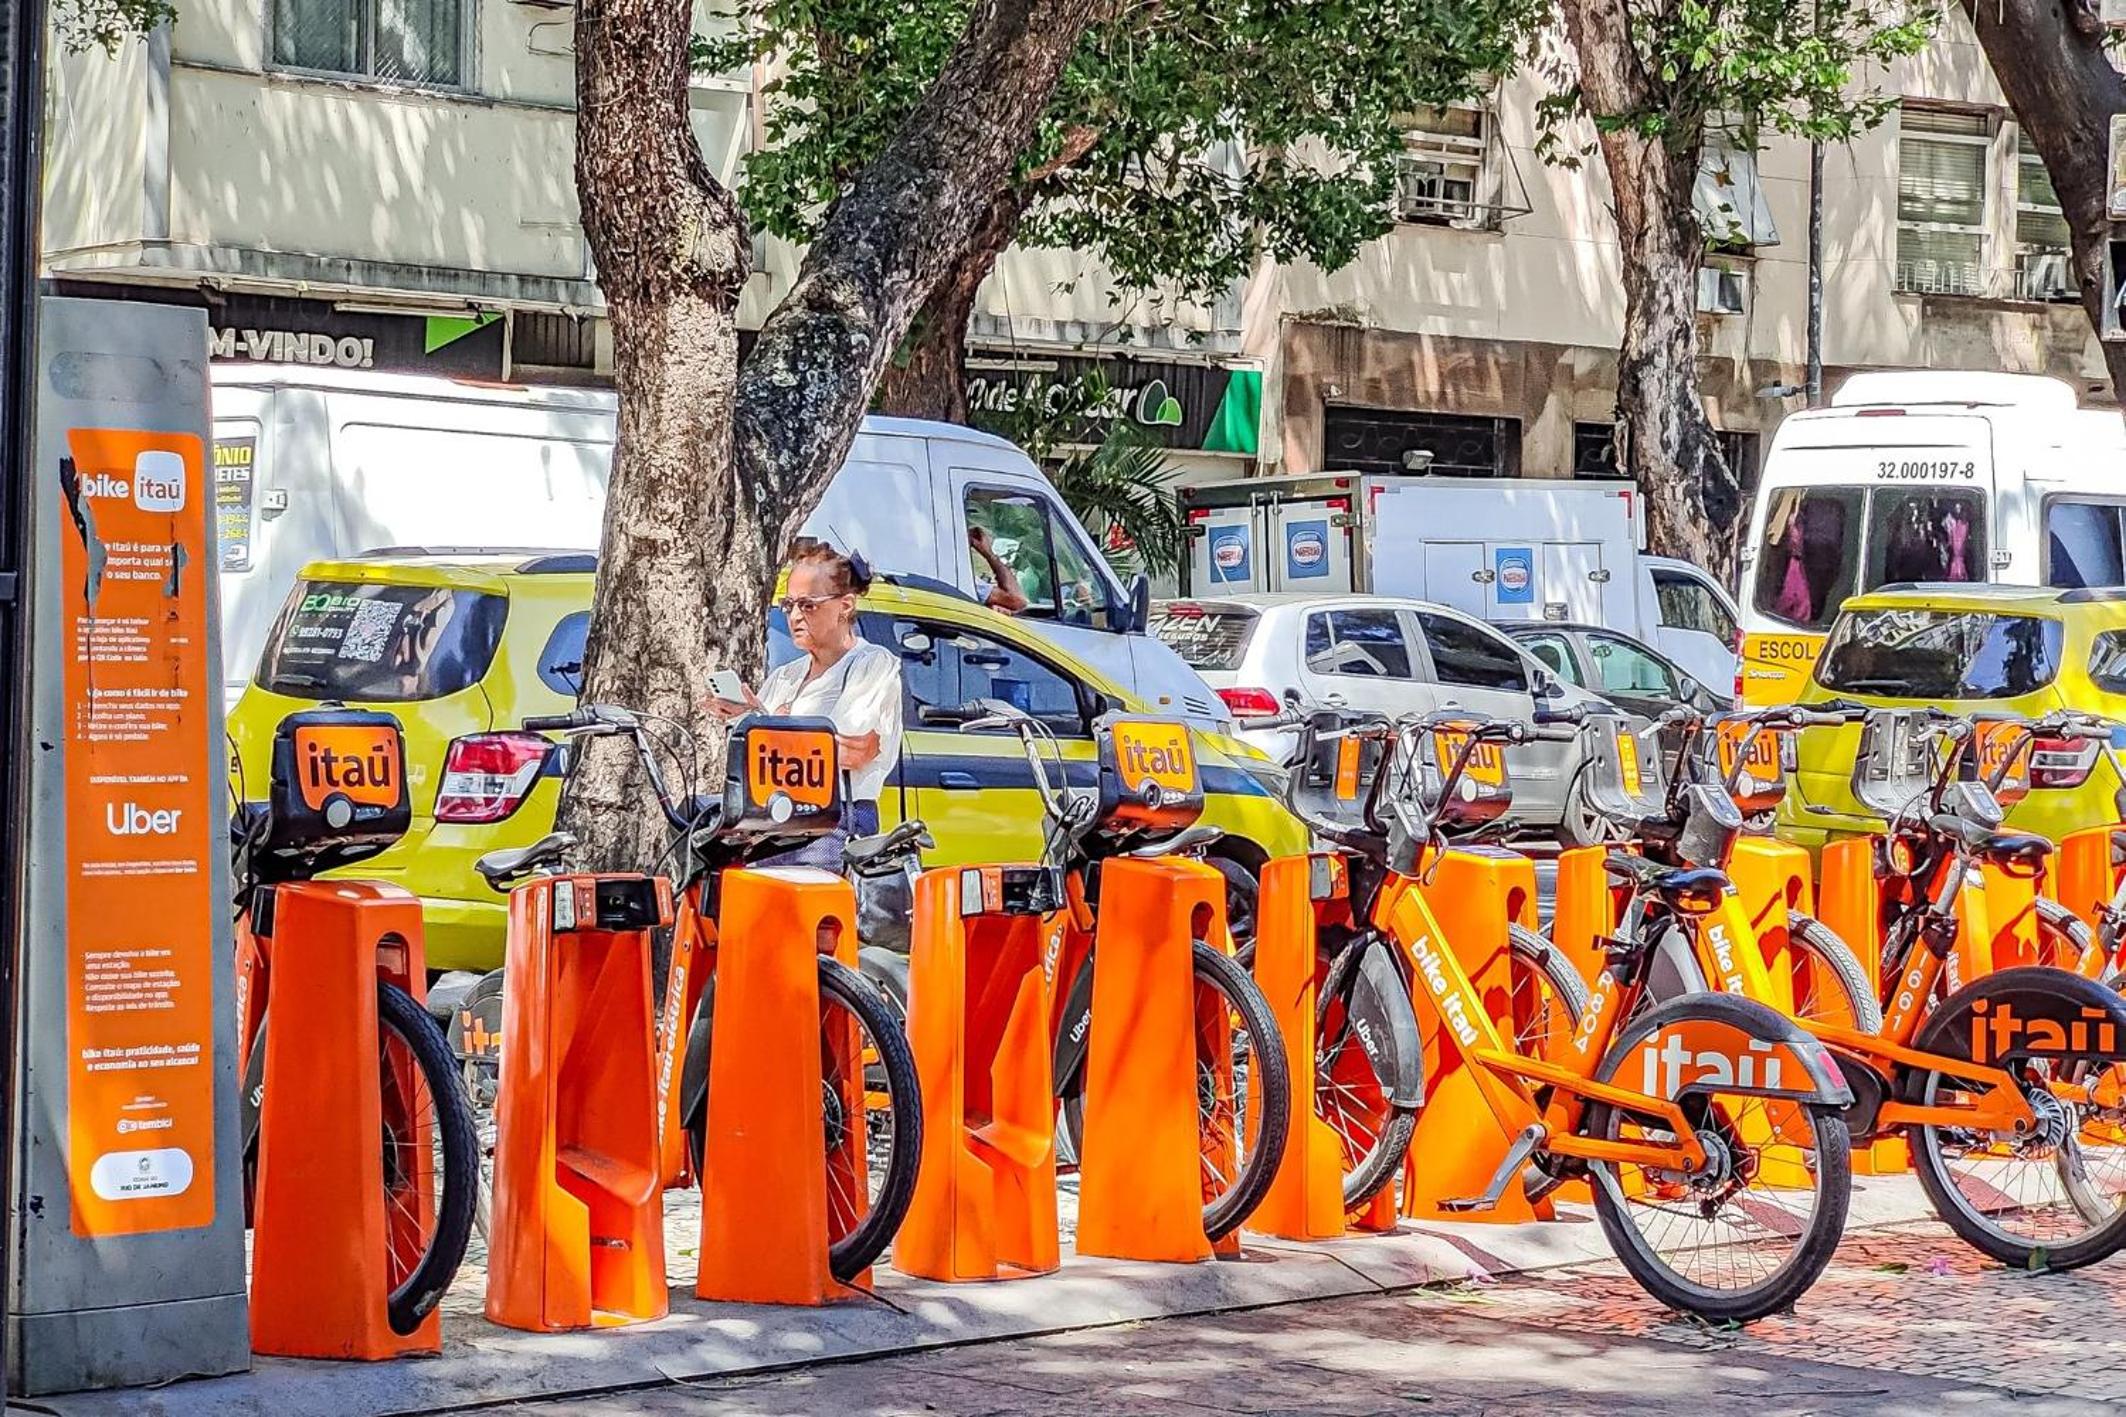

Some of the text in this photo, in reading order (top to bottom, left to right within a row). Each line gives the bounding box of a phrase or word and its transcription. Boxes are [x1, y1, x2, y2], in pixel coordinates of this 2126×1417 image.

[83, 473, 181, 499] bike itaú
[1877, 462, 1975, 480] 32.000197-8
[1759, 641, 1823, 660] ESCOL
[307, 742, 391, 788] itaú
[759, 743, 825, 788] itaú
[1123, 734, 1186, 775] itaú
[107, 802, 182, 836] Uber
[1411, 934, 1449, 996] bike
[1708, 924, 1735, 973] bike
[1356, 1018, 1379, 1056] Uber
[1971, 998, 2116, 1064] itaú
